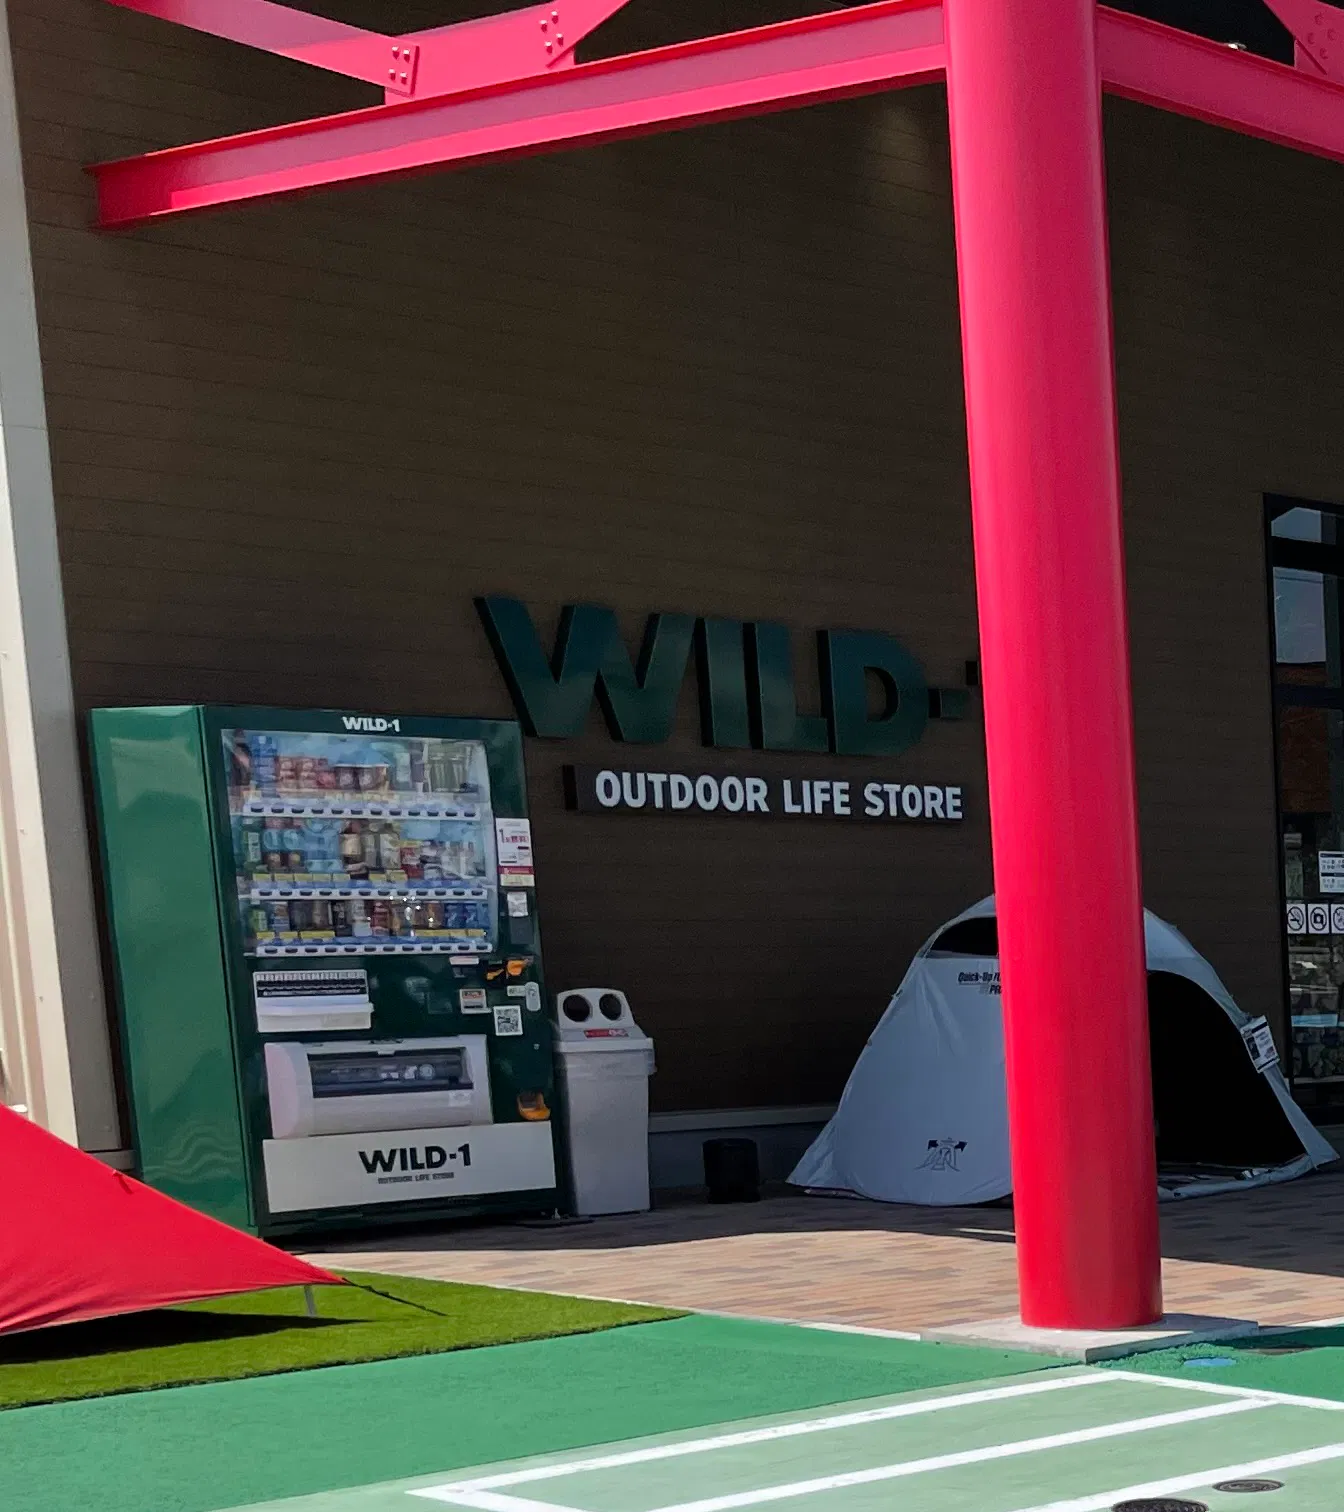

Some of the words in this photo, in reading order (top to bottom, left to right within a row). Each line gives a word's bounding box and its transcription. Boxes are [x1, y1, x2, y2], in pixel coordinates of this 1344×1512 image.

[474, 593, 979, 757] WILD-
[342, 716, 401, 732] WILD-1
[595, 770, 770, 812] OUTDOOR
[783, 778, 851, 816] LIFE
[863, 781, 963, 820] STORE
[358, 1143, 472, 1174] WILD-1
